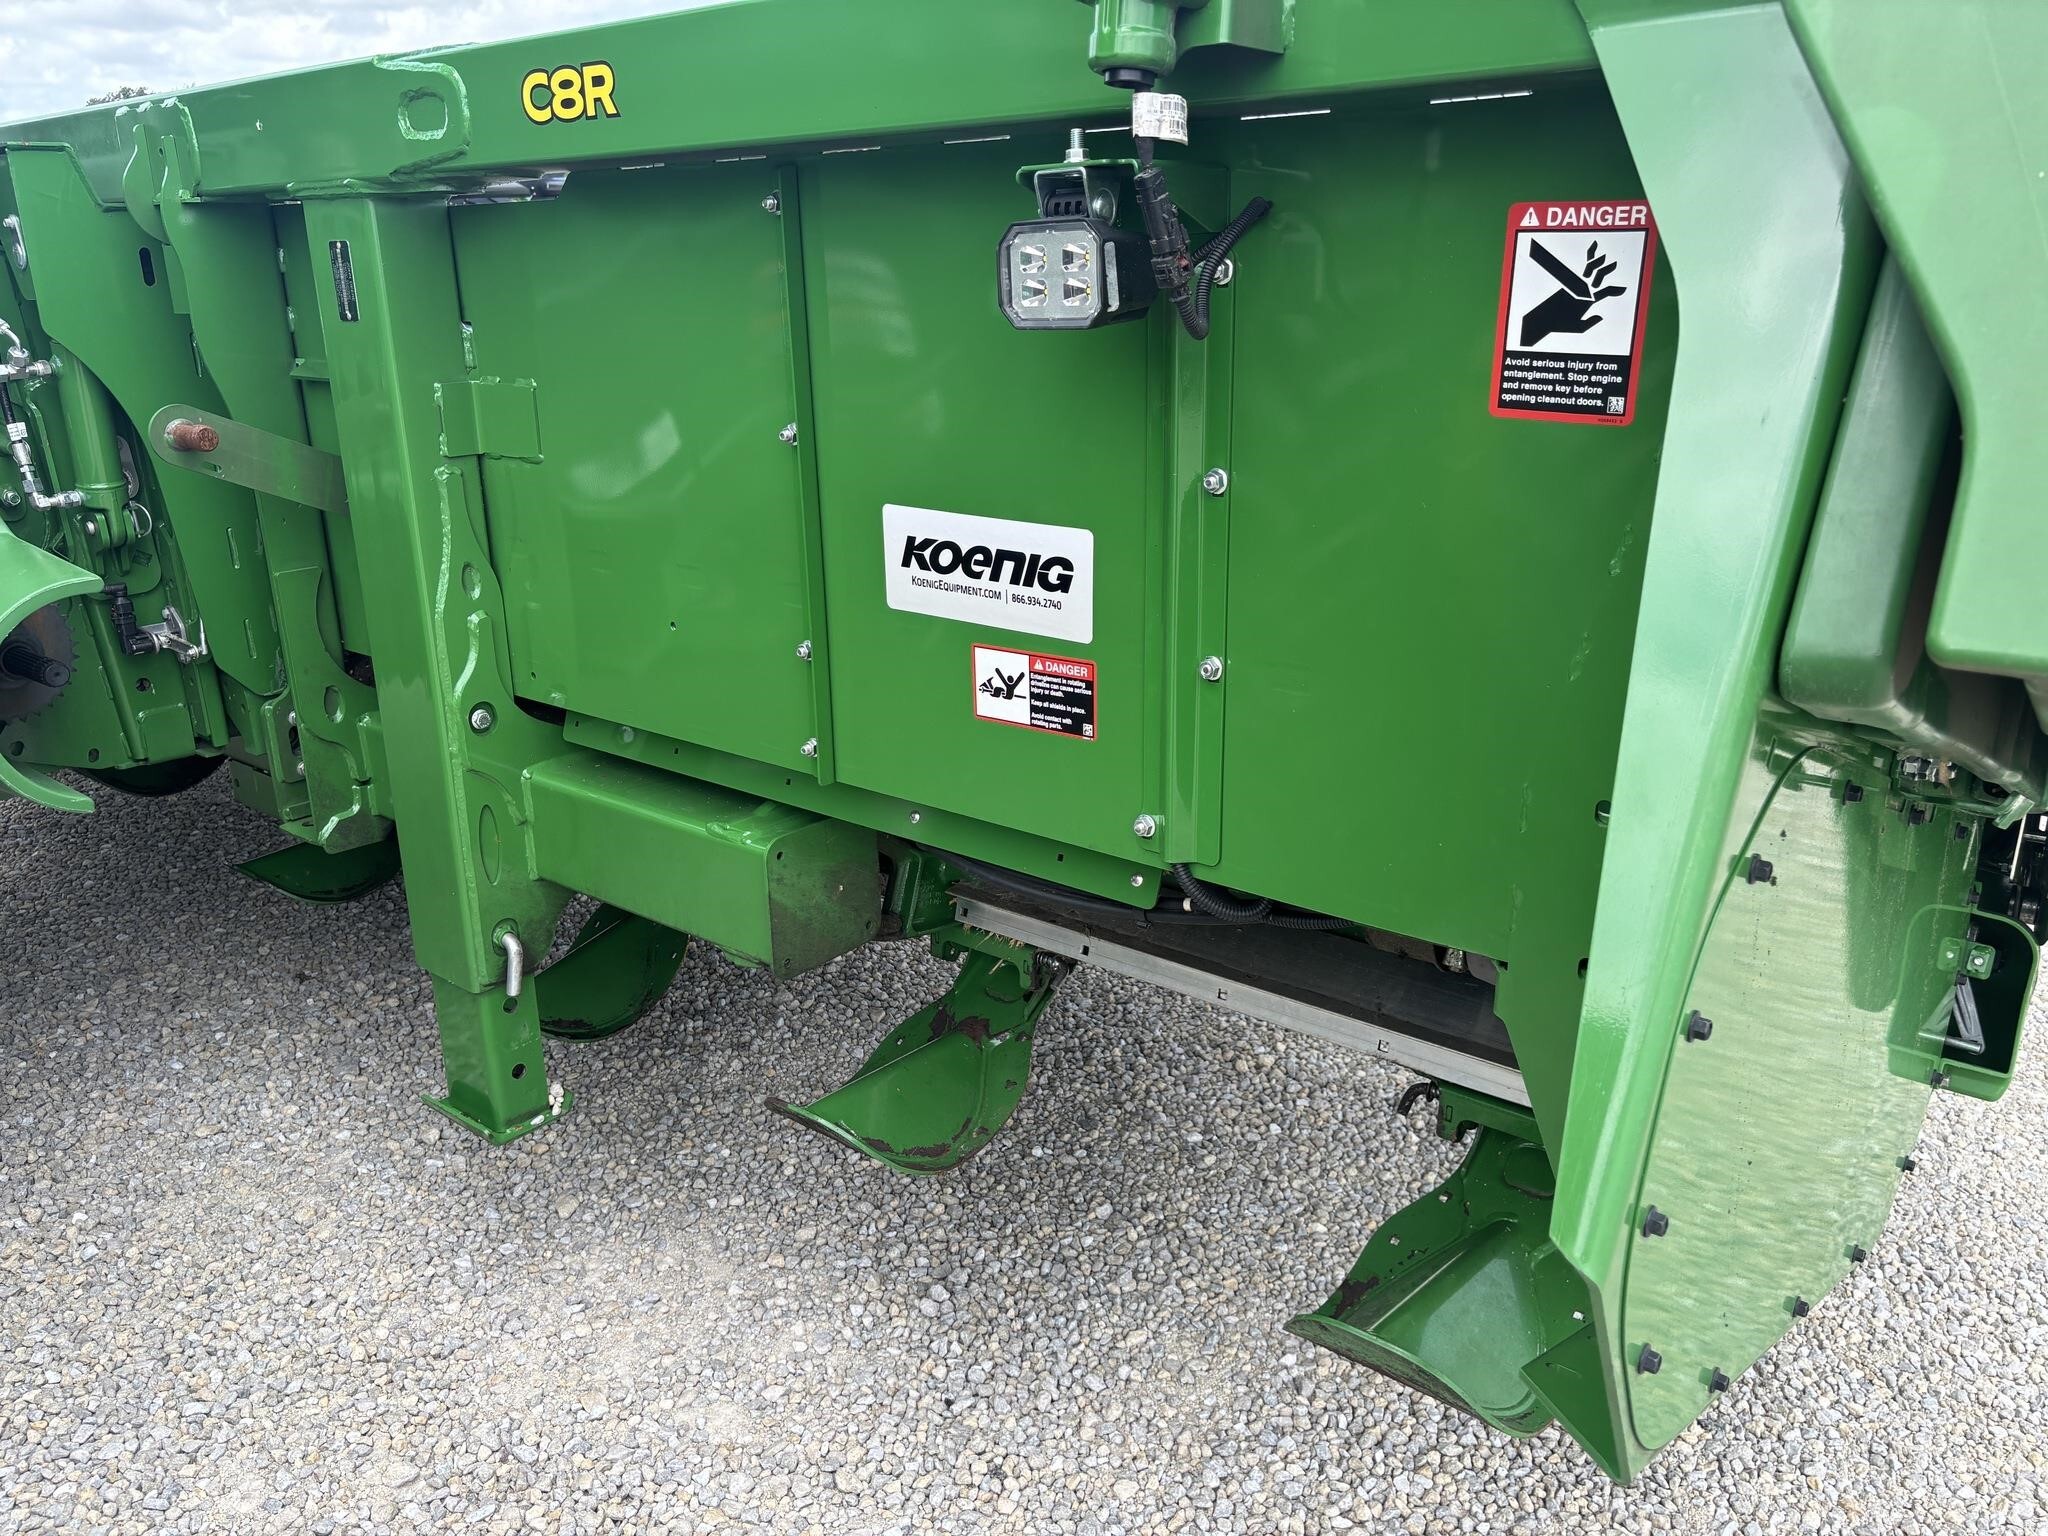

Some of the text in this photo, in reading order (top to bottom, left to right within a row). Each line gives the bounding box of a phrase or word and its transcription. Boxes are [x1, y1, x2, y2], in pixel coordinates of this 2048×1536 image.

[521, 60, 621, 125] C8R
[1546, 205, 1647, 227] DANGER
[1505, 357, 1618, 371] Avoid serious injury from
[1503, 369, 1623, 384] entanglement. Stop engine
[1502, 381, 1603, 395] and remove key before
[1501, 393, 1604, 407] opening cleanout doors.
[1011, 593, 1062, 611] 866.934.2740
[1045, 661, 1088, 678] DANGER
